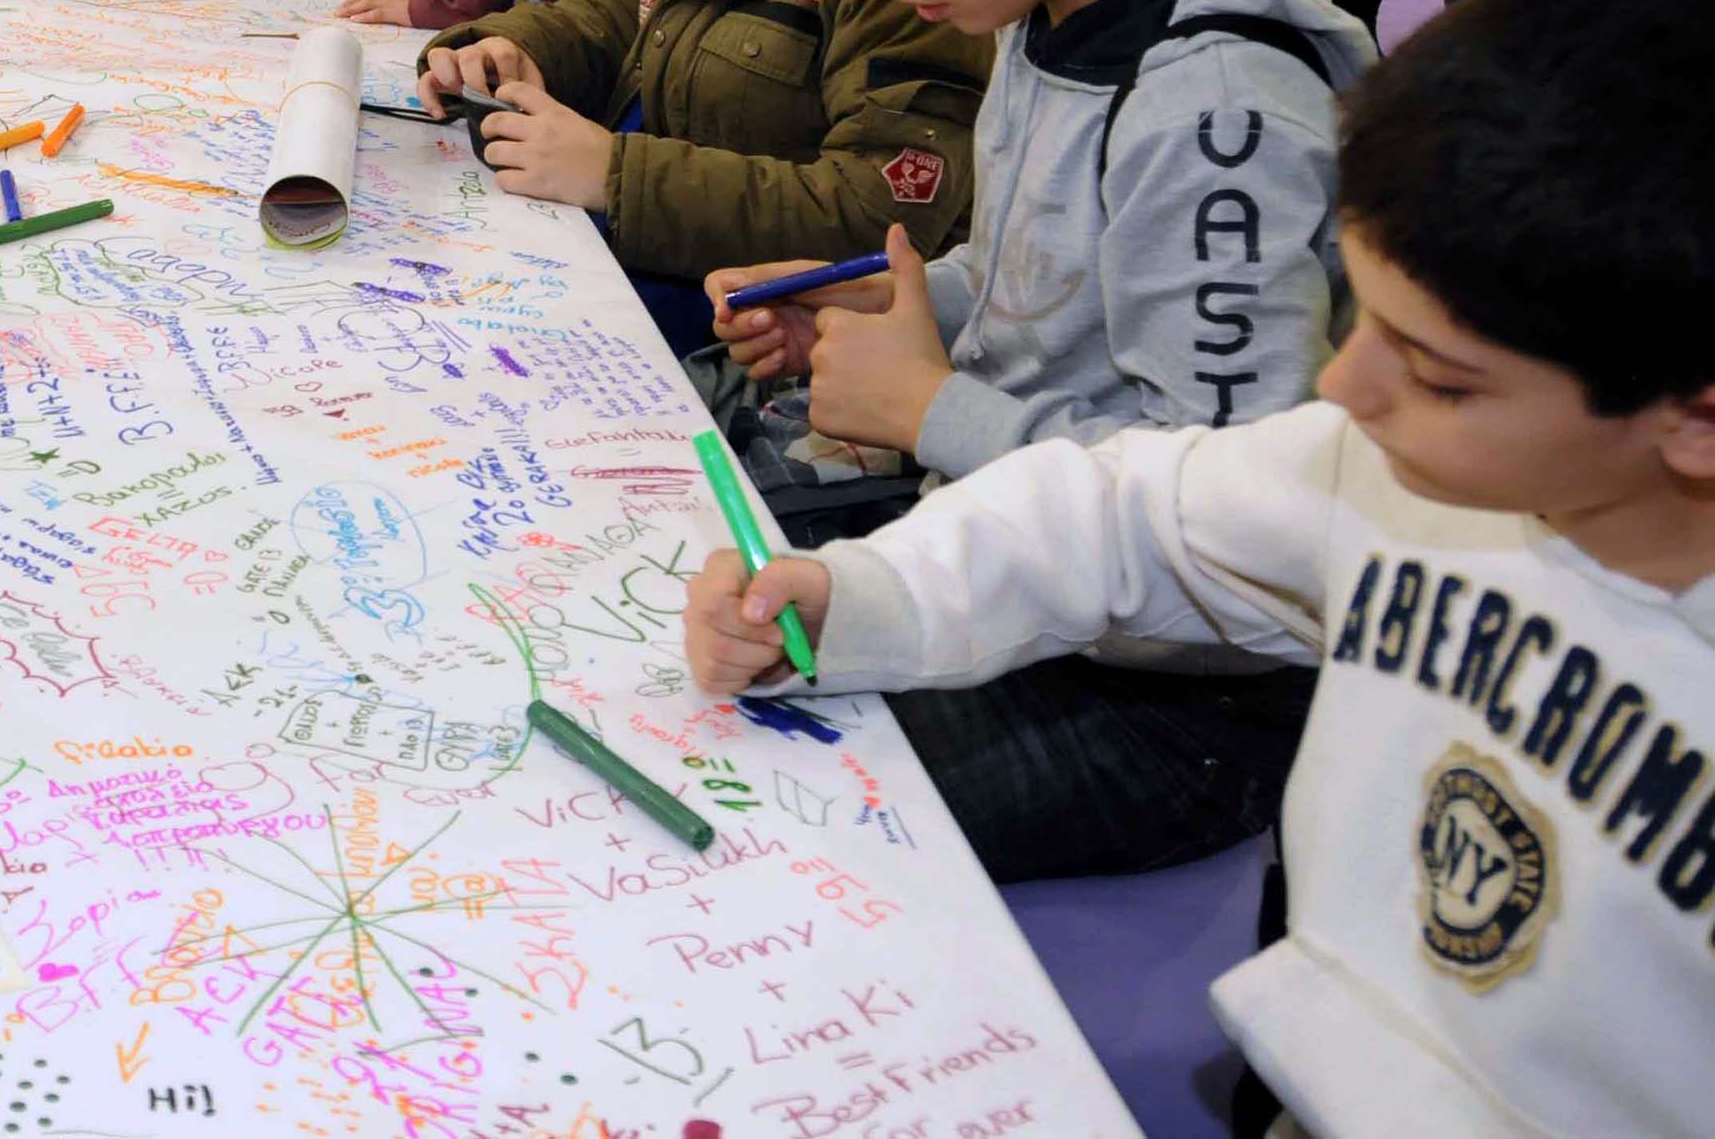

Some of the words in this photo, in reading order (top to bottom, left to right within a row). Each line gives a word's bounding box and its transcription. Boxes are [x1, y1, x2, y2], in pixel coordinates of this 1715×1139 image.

[590, 540, 701, 643] ViCK
[1331, 551, 1715, 951] ABERCROMB
[1435, 813, 1510, 906] NY
[148, 1084, 217, 1118] Hi!
